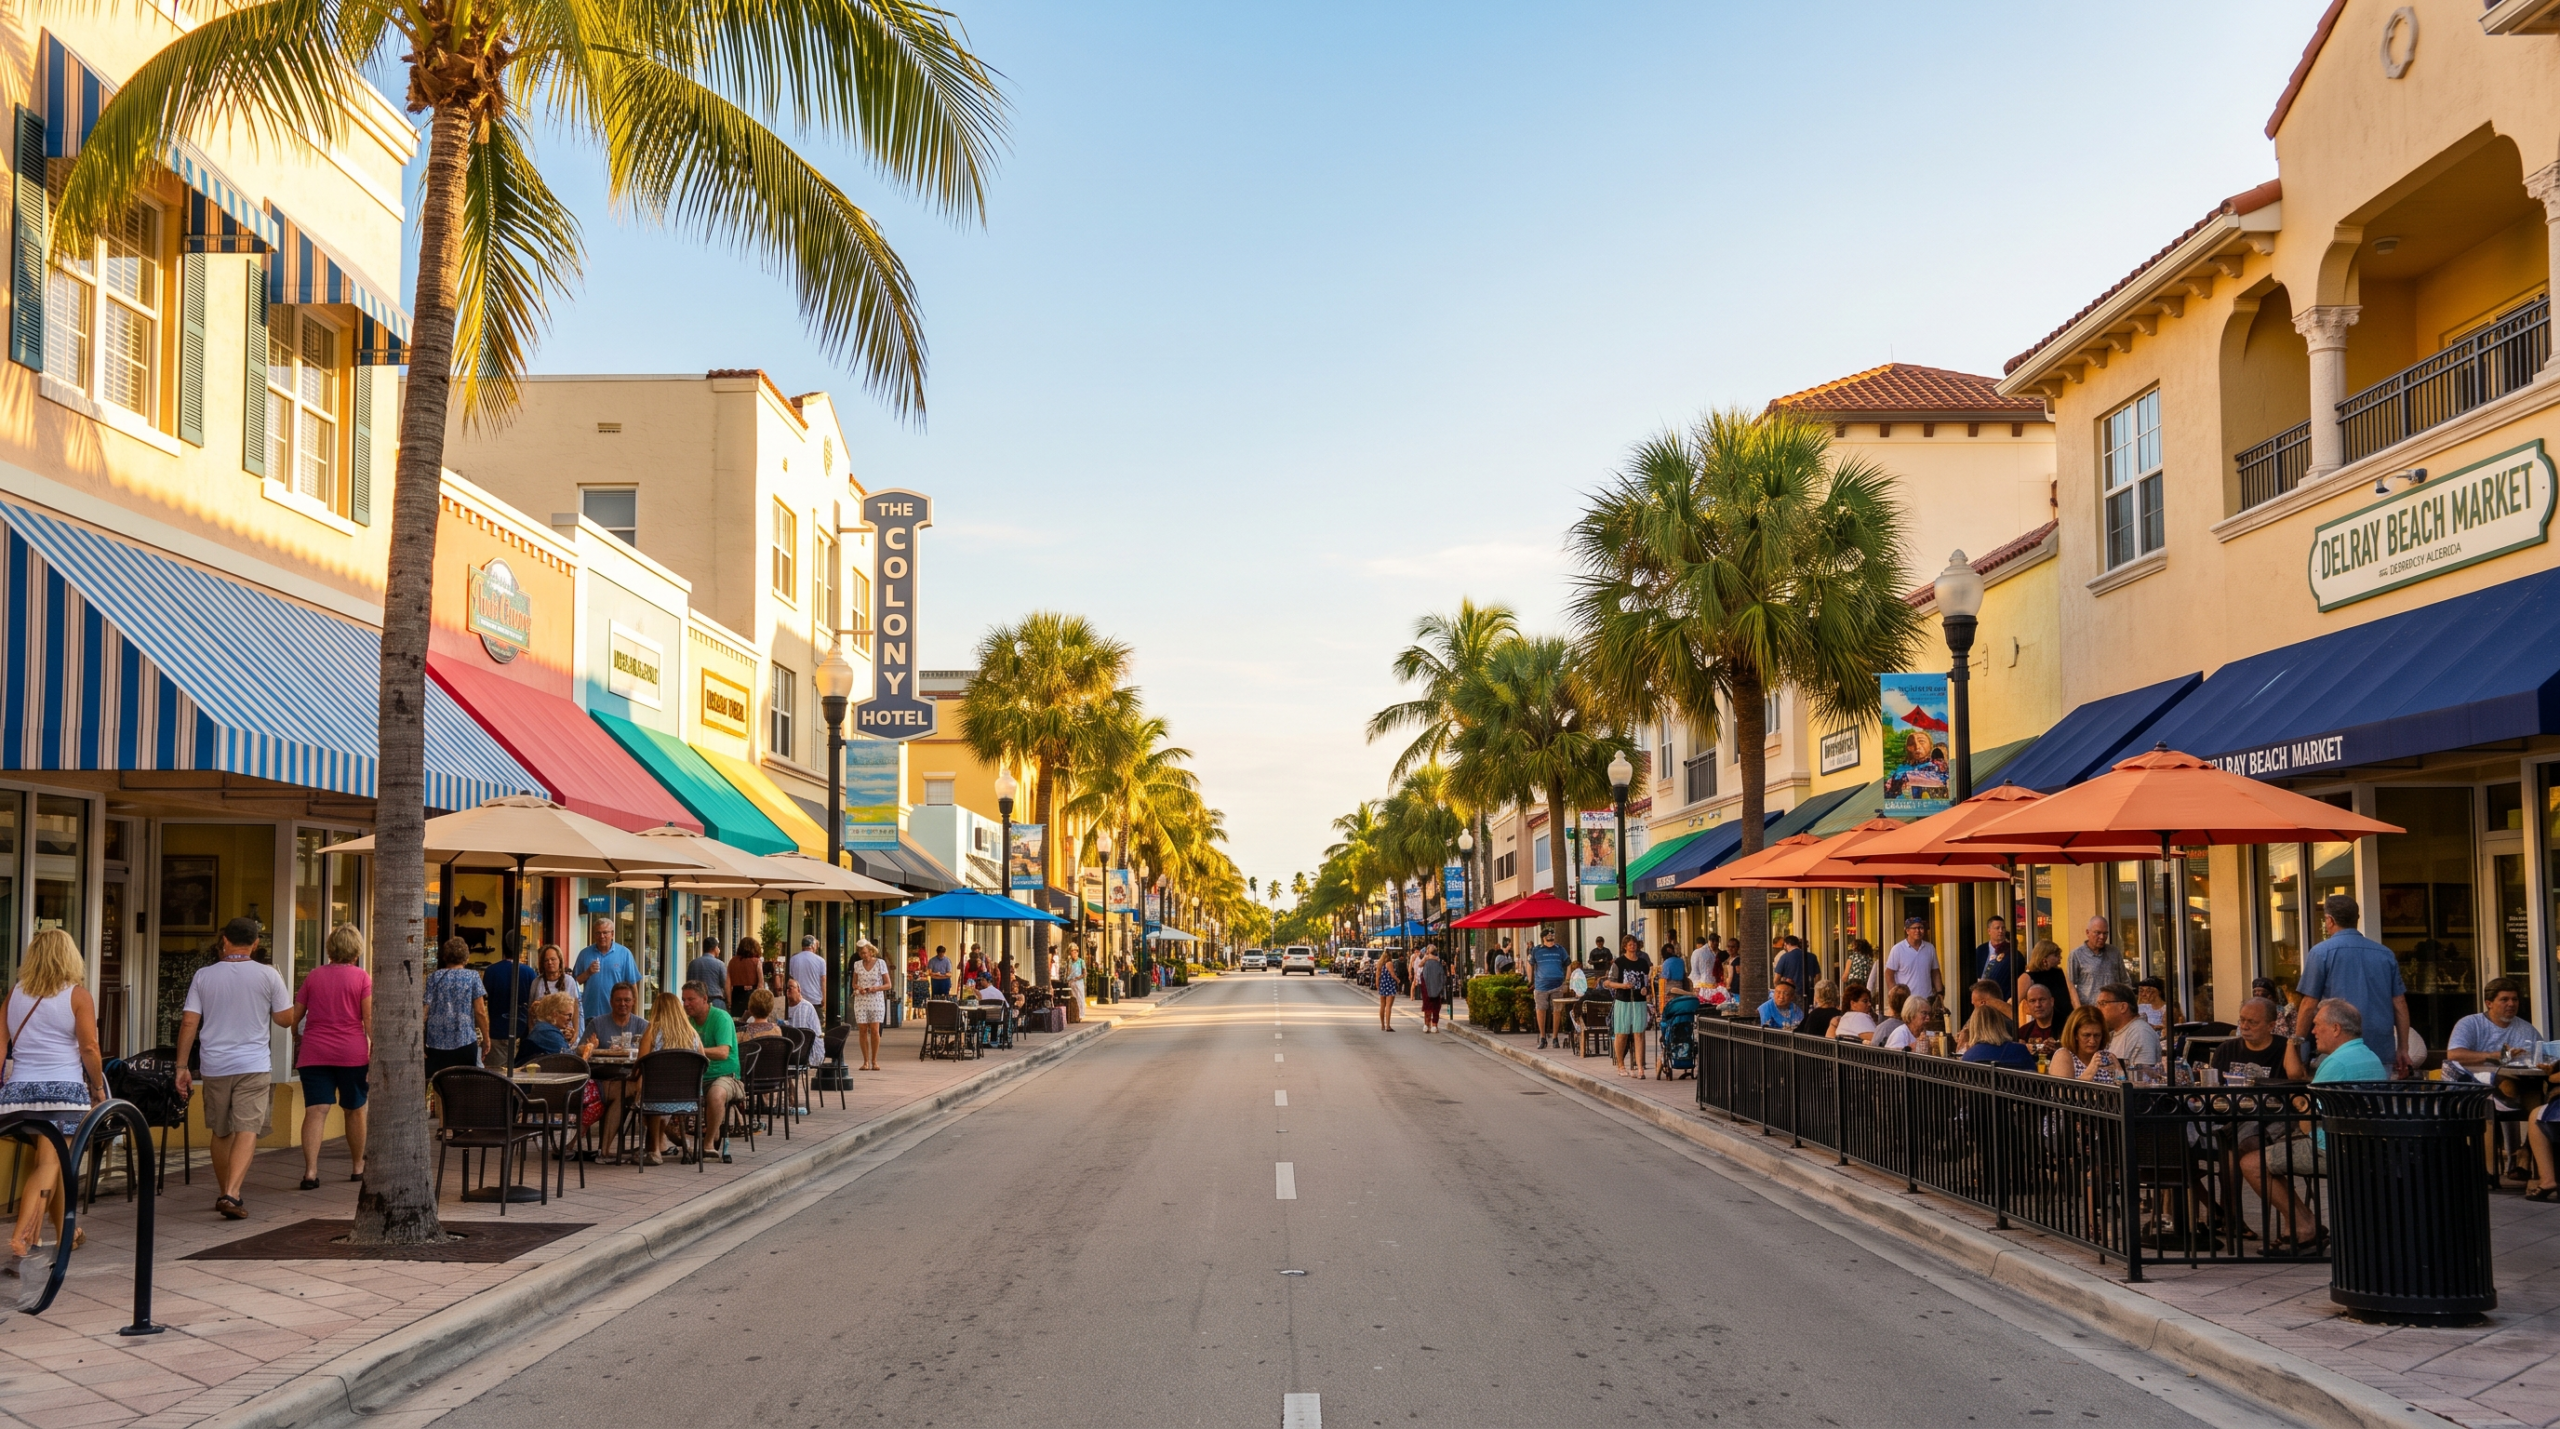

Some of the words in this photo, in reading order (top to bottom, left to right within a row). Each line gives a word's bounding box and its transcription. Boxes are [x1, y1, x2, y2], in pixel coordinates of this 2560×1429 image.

[877, 502, 914, 517] THE
[2321, 518, 2381, 580] DELRAY
[2387, 494, 2445, 557] BEACH
[2452, 461, 2533, 534] MARKET
[883, 527, 908, 695] COLONY
[861, 709, 928, 726] HOTEL
[2249, 745, 2288, 775] BEACH
[2291, 735, 2344, 768] MARKET
